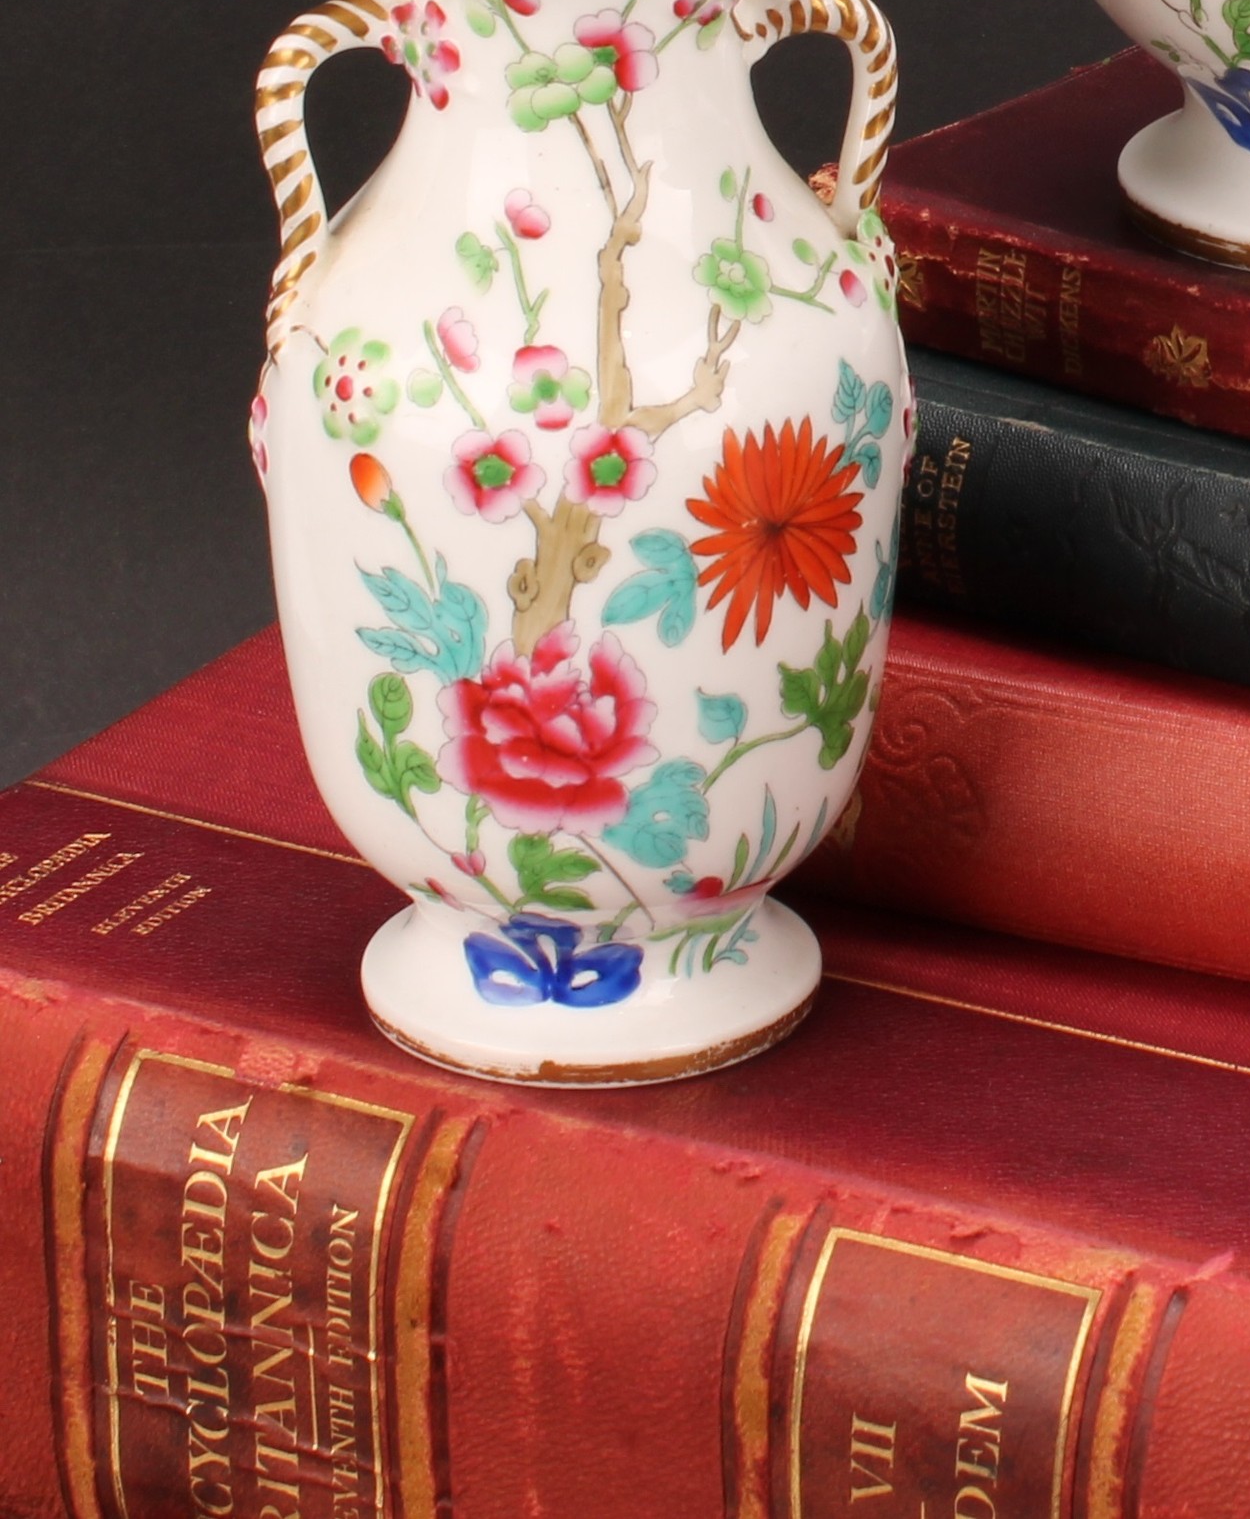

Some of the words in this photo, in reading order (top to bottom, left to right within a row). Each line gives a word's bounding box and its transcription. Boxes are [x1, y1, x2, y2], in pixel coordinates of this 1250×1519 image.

[976, 246, 1004, 355] MARTIN
[1059, 266, 1083, 376] DICKENS
[916, 454, 938, 498] OF
[18, 851, 146, 926] BRITANNICA
[90, 871, 193, 936] ELEVENTH
[129, 886, 213, 937] EDITION
[130, 1279, 170, 1397] THE
[180, 1094, 254, 1519] CYCLOPÆDIA
[326, 1203, 360, 1367] EDITION
[850, 1410, 897, 1505] VII
[953, 1370, 1008, 1519] DEM
